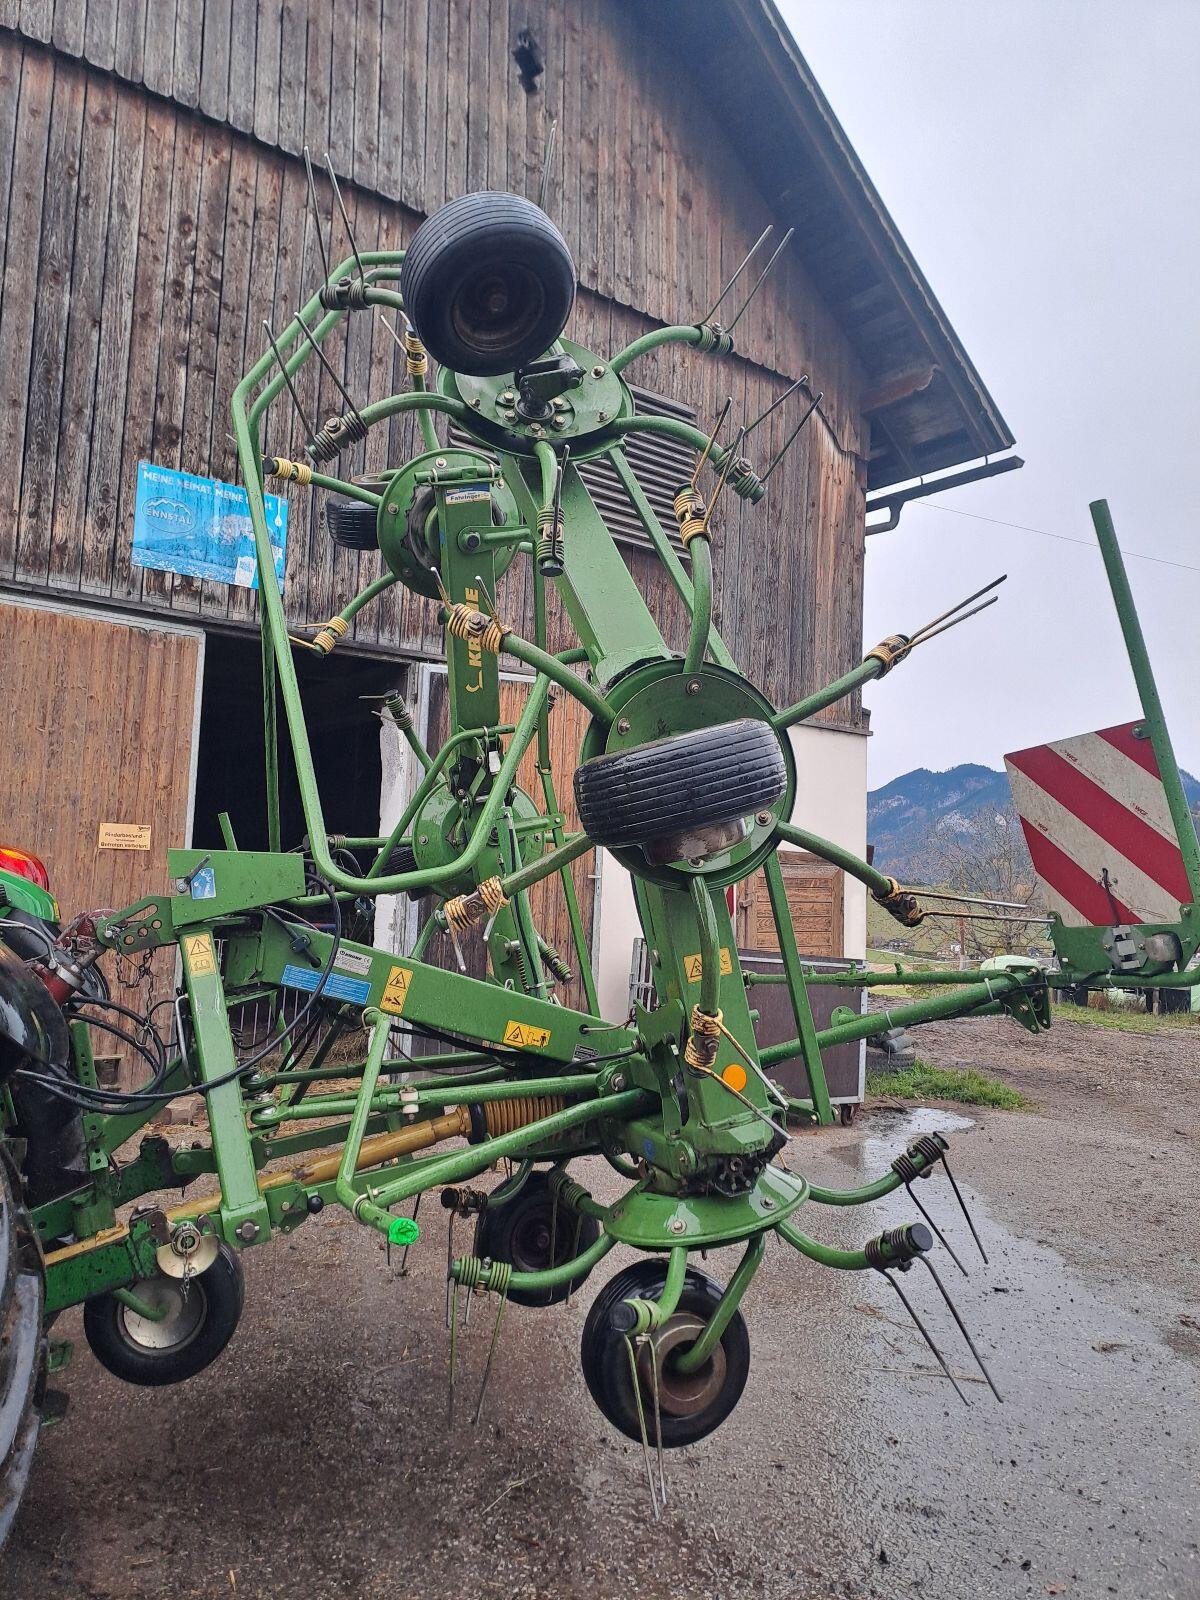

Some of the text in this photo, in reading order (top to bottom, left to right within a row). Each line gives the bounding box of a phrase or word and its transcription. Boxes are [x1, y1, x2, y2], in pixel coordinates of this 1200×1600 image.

[144, 471, 174, 486] MEINE
[215, 489, 243, 503] MEINE
[146, 508, 191, 525] ENNSTAL
[465, 588, 482, 667] KRE
